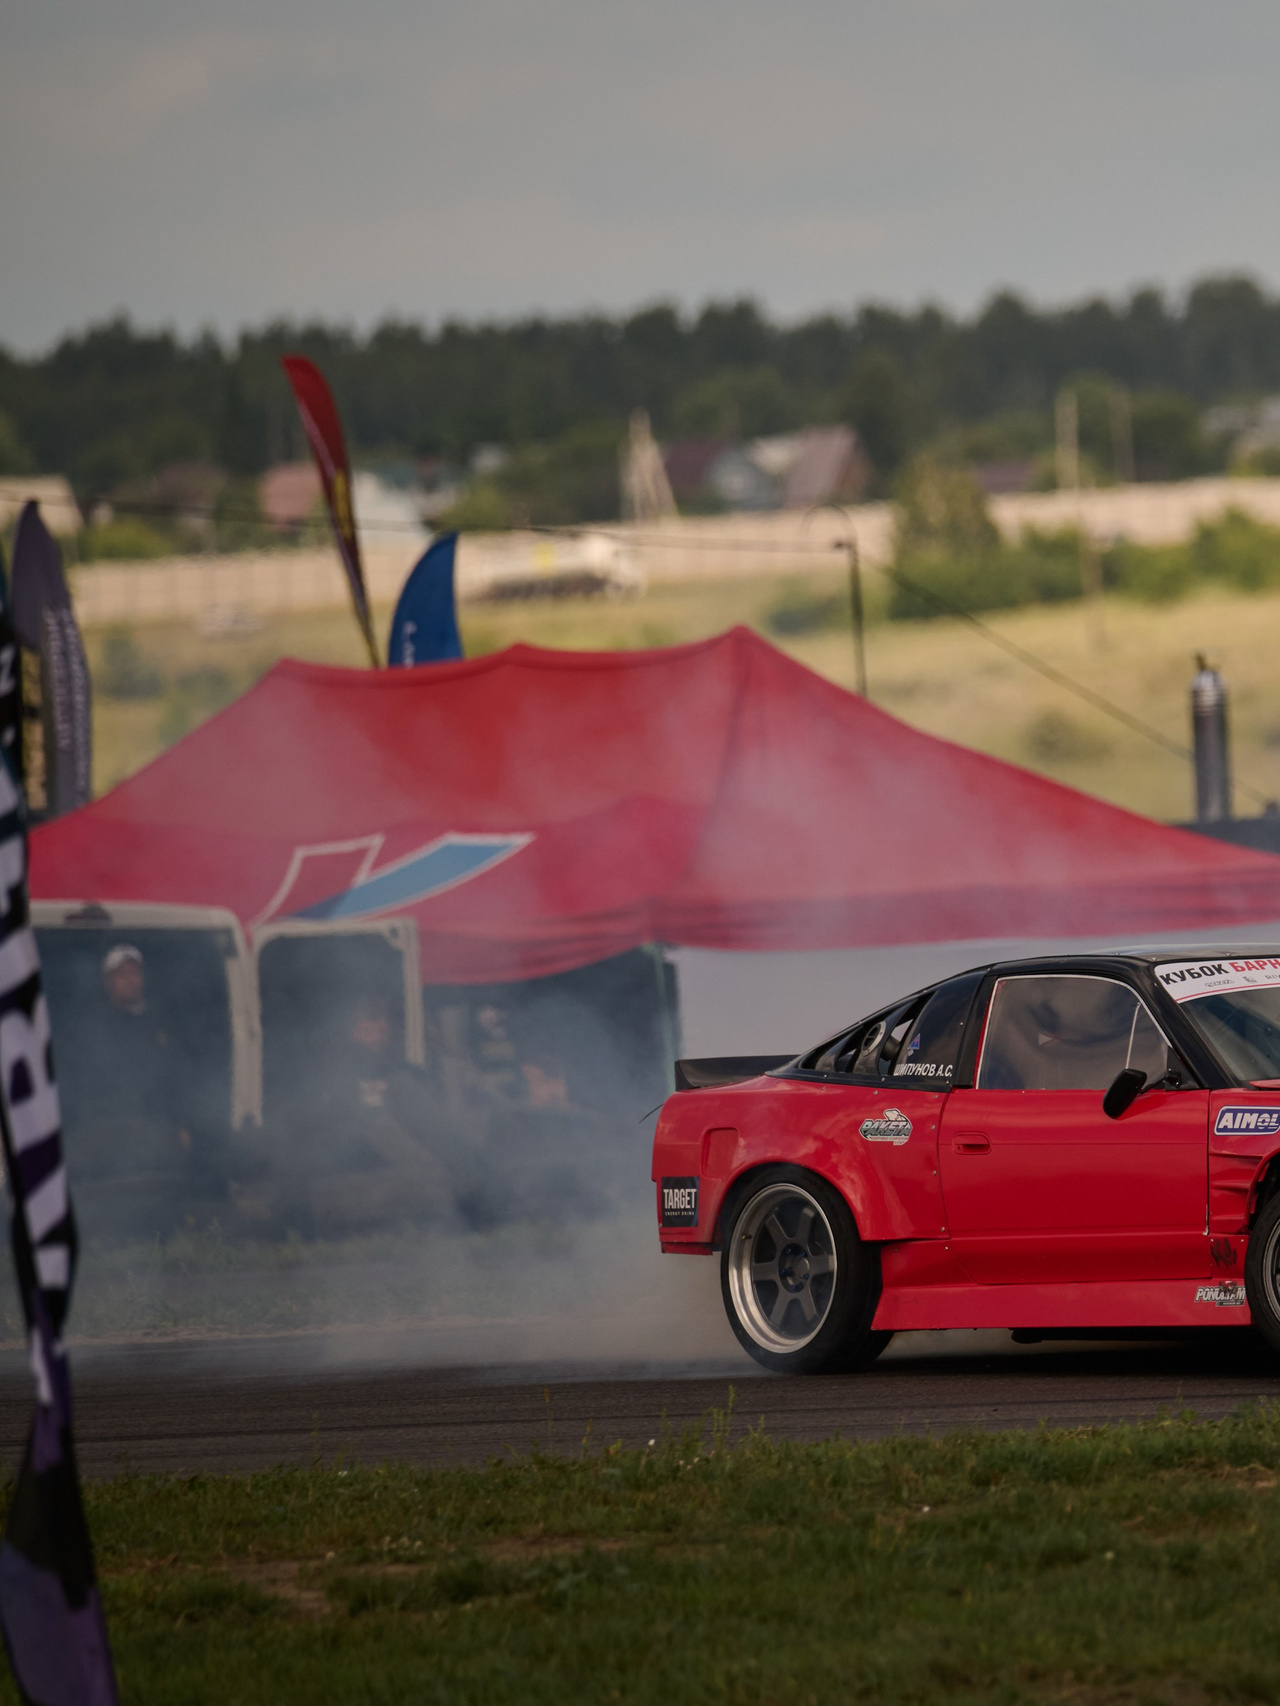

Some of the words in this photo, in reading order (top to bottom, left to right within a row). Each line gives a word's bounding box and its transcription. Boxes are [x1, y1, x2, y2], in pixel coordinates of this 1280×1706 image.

[1159, 963, 1229, 985] КУБОК
[893, 1063, 936, 1076] ШИПУНОВ
[663, 1188, 697, 1209] TARGET
